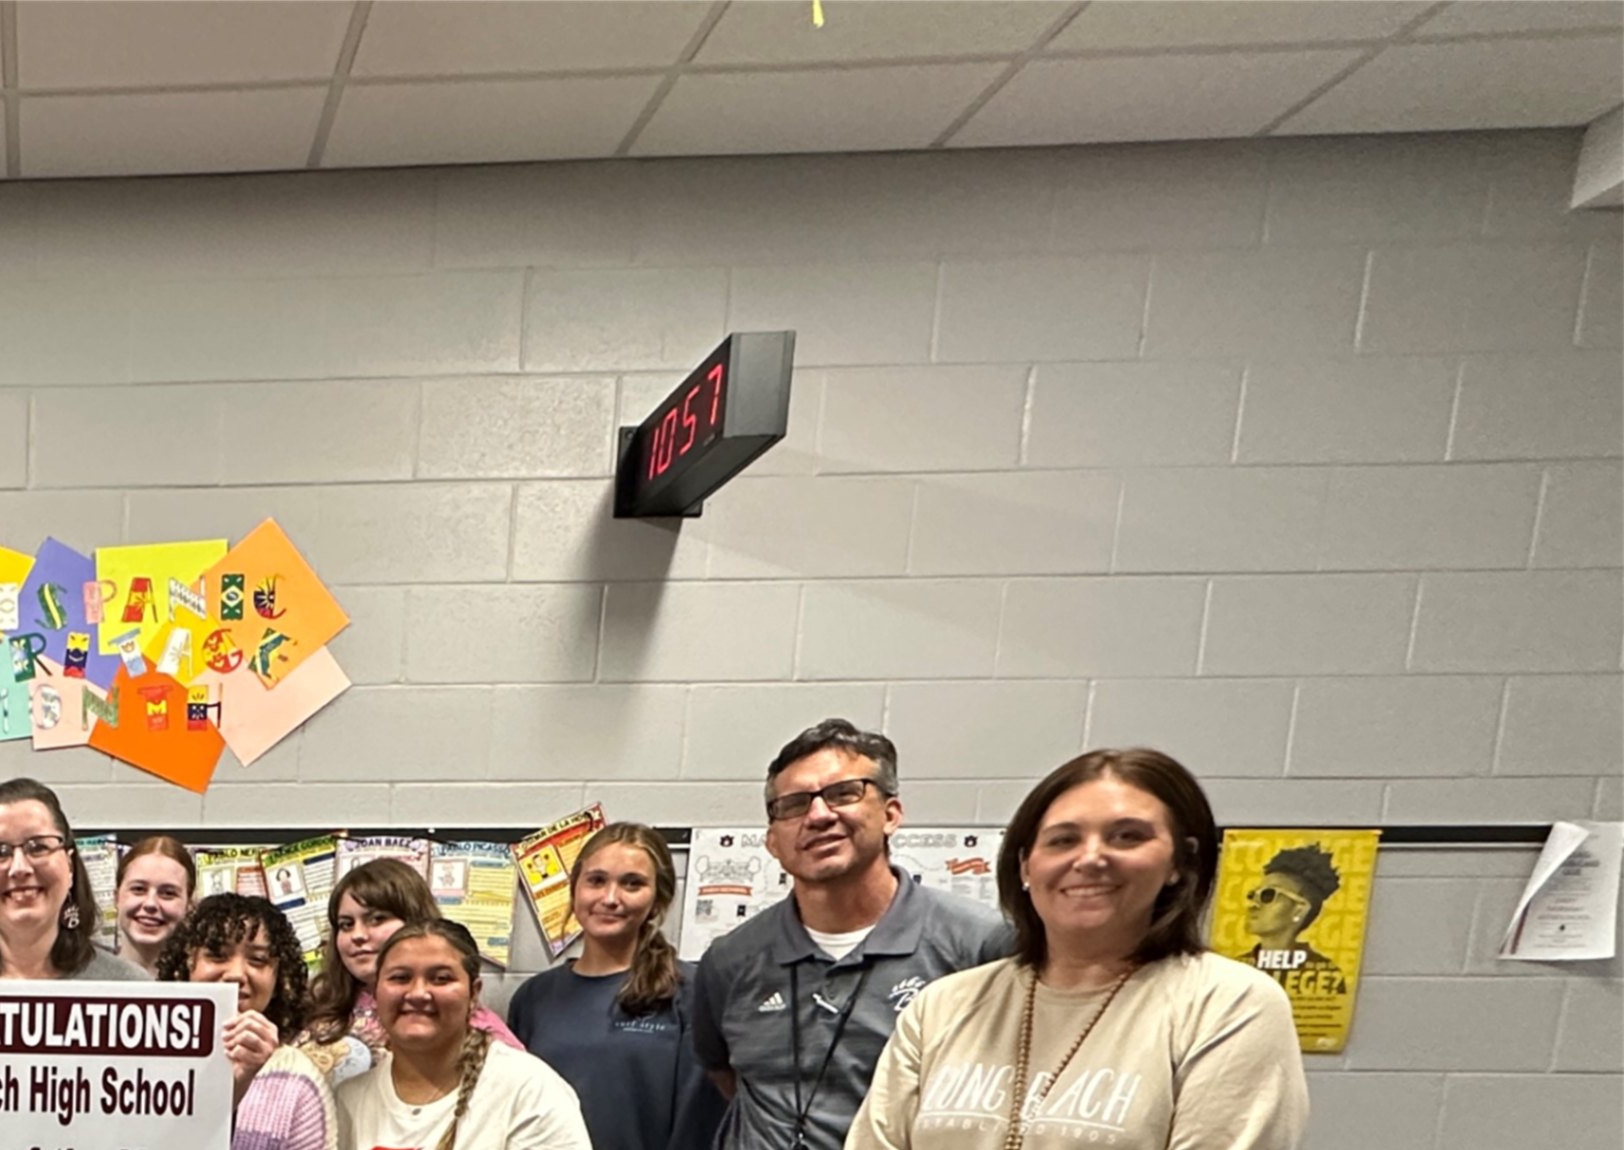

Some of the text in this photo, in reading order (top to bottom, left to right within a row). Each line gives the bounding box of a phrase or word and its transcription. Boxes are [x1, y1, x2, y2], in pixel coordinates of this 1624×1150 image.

[1257, 950, 1307, 968] HELP
[29, 1066, 91, 1126] High
[101, 1067, 195, 1116] School
